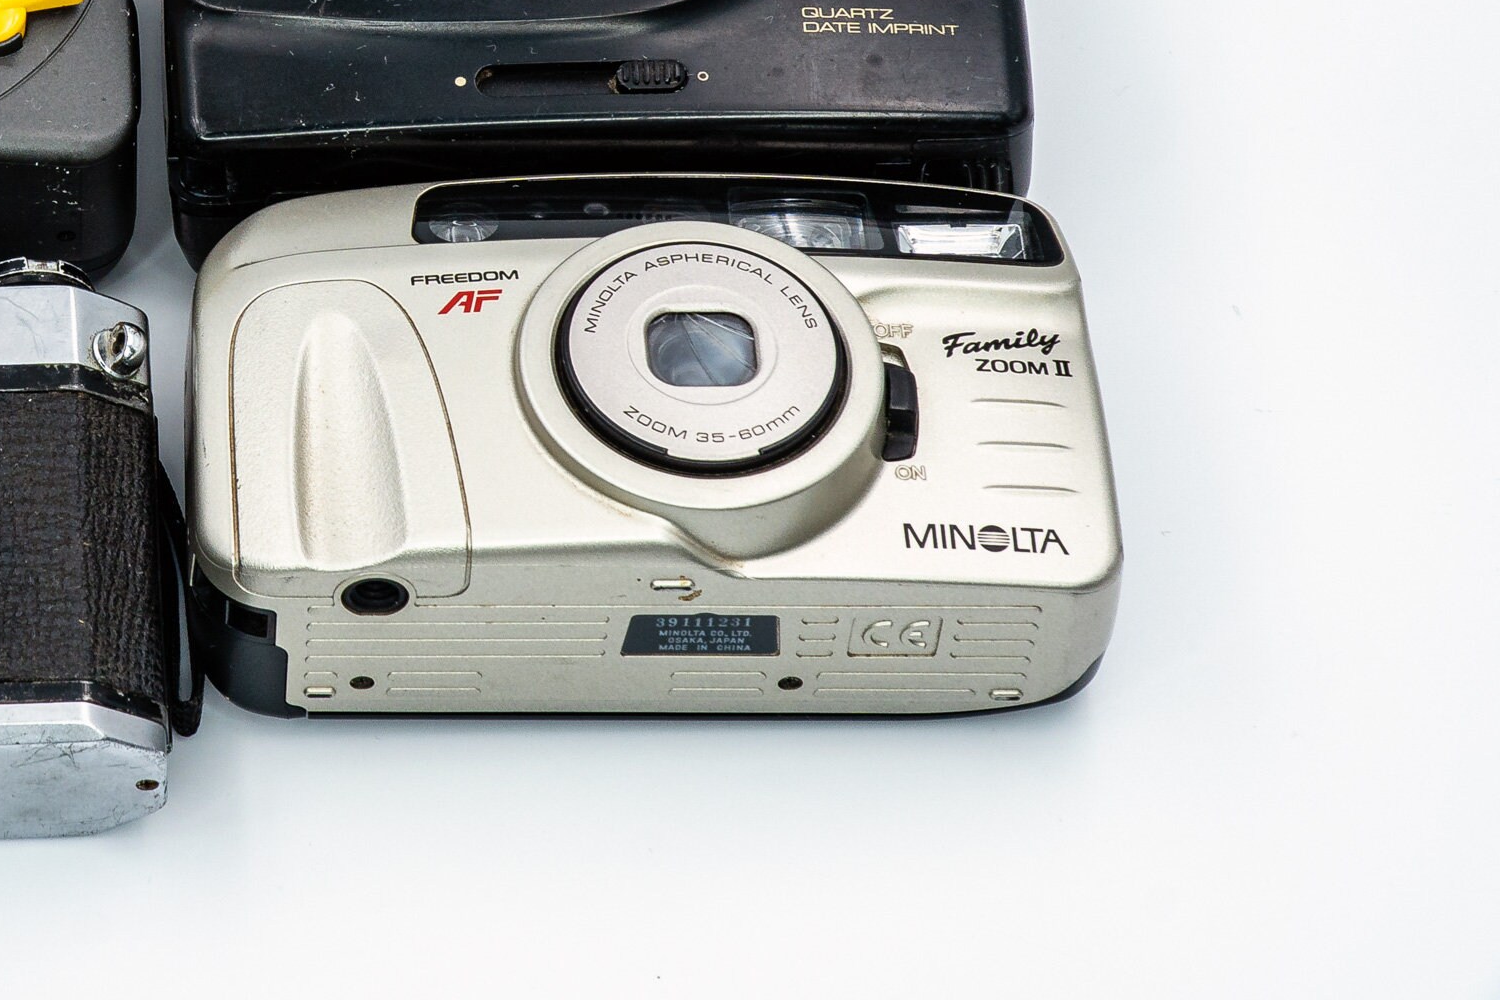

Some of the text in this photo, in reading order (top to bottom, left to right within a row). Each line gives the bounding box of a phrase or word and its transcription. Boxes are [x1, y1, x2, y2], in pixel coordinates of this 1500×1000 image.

[801, 7, 894, 19] QUARTZ
[803, 22, 959, 35] DATE IMPRINT
[411, 270, 519, 285] FREEDOM
[437, 289, 502, 315] AF
[584, 253, 818, 333] MINOLTA ASPHERICAL LENS
[874, 323, 913, 338] OFF
[942, 328, 1060, 357] Family
[975, 359, 1073, 377] ZOOM II
[623, 405, 801, 442] ZOOM 35-60mm
[895, 465, 926, 480] ON
[903, 523, 1069, 555] MINOLTA
